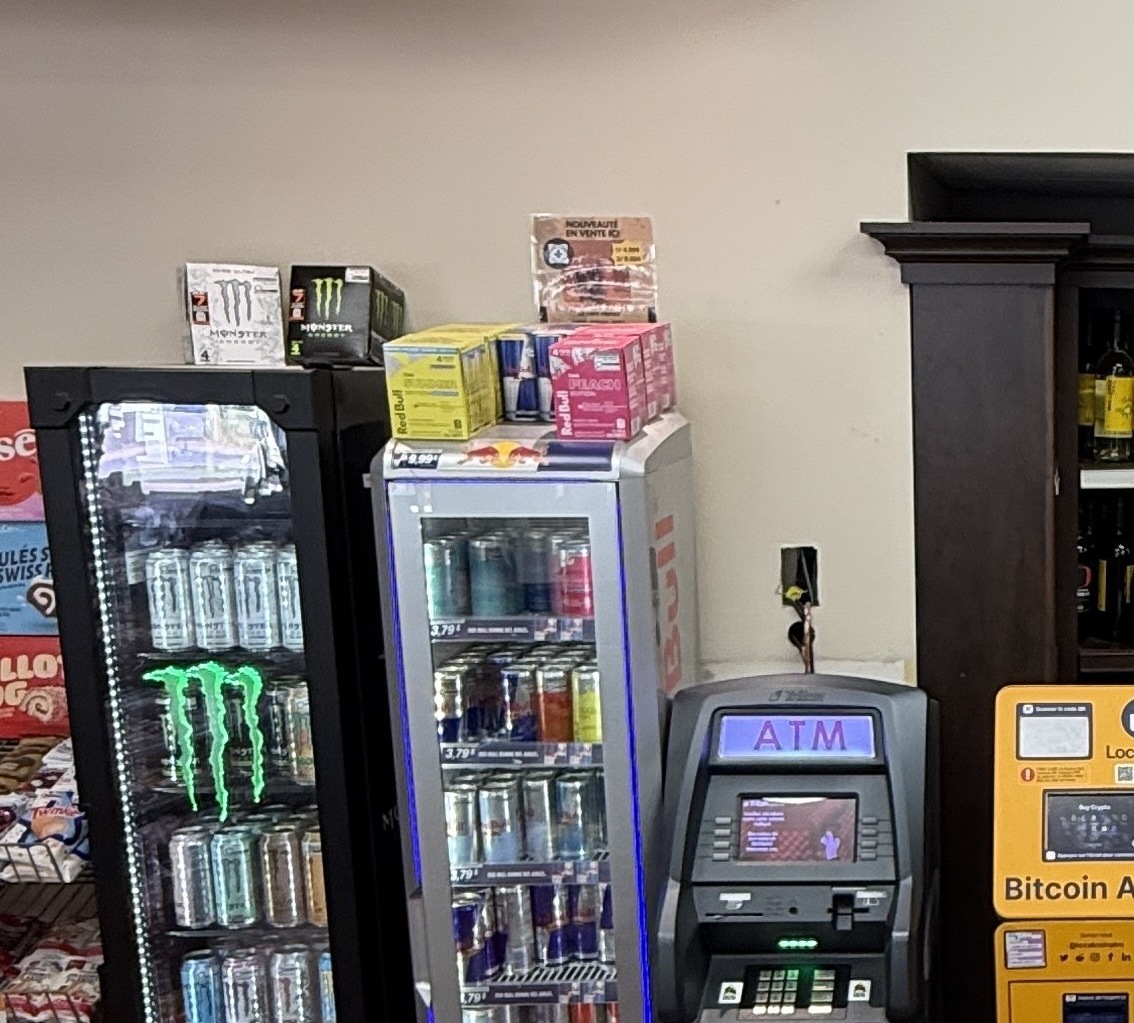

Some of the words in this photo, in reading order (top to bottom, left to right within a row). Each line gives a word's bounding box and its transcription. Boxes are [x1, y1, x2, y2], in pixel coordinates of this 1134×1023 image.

[565, 220, 619, 229] NOUVEAUTÉ
[565, 229, 578, 238] EN
[579, 229, 607, 238] VENTE
[209, 329, 268, 339] MONSTER
[300, 323, 354, 333] MONSTER
[200, 350, 209, 361] 4
[568, 378, 622, 391] PEACH
[392, 389, 405, 410] Bull
[556, 390, 571, 412] Bull
[395, 410, 408, 435] Red
[557, 413, 573, 436] Red
[753, 720, 847, 751] ATM
[1005, 874, 1108, 901] Bitcoin
